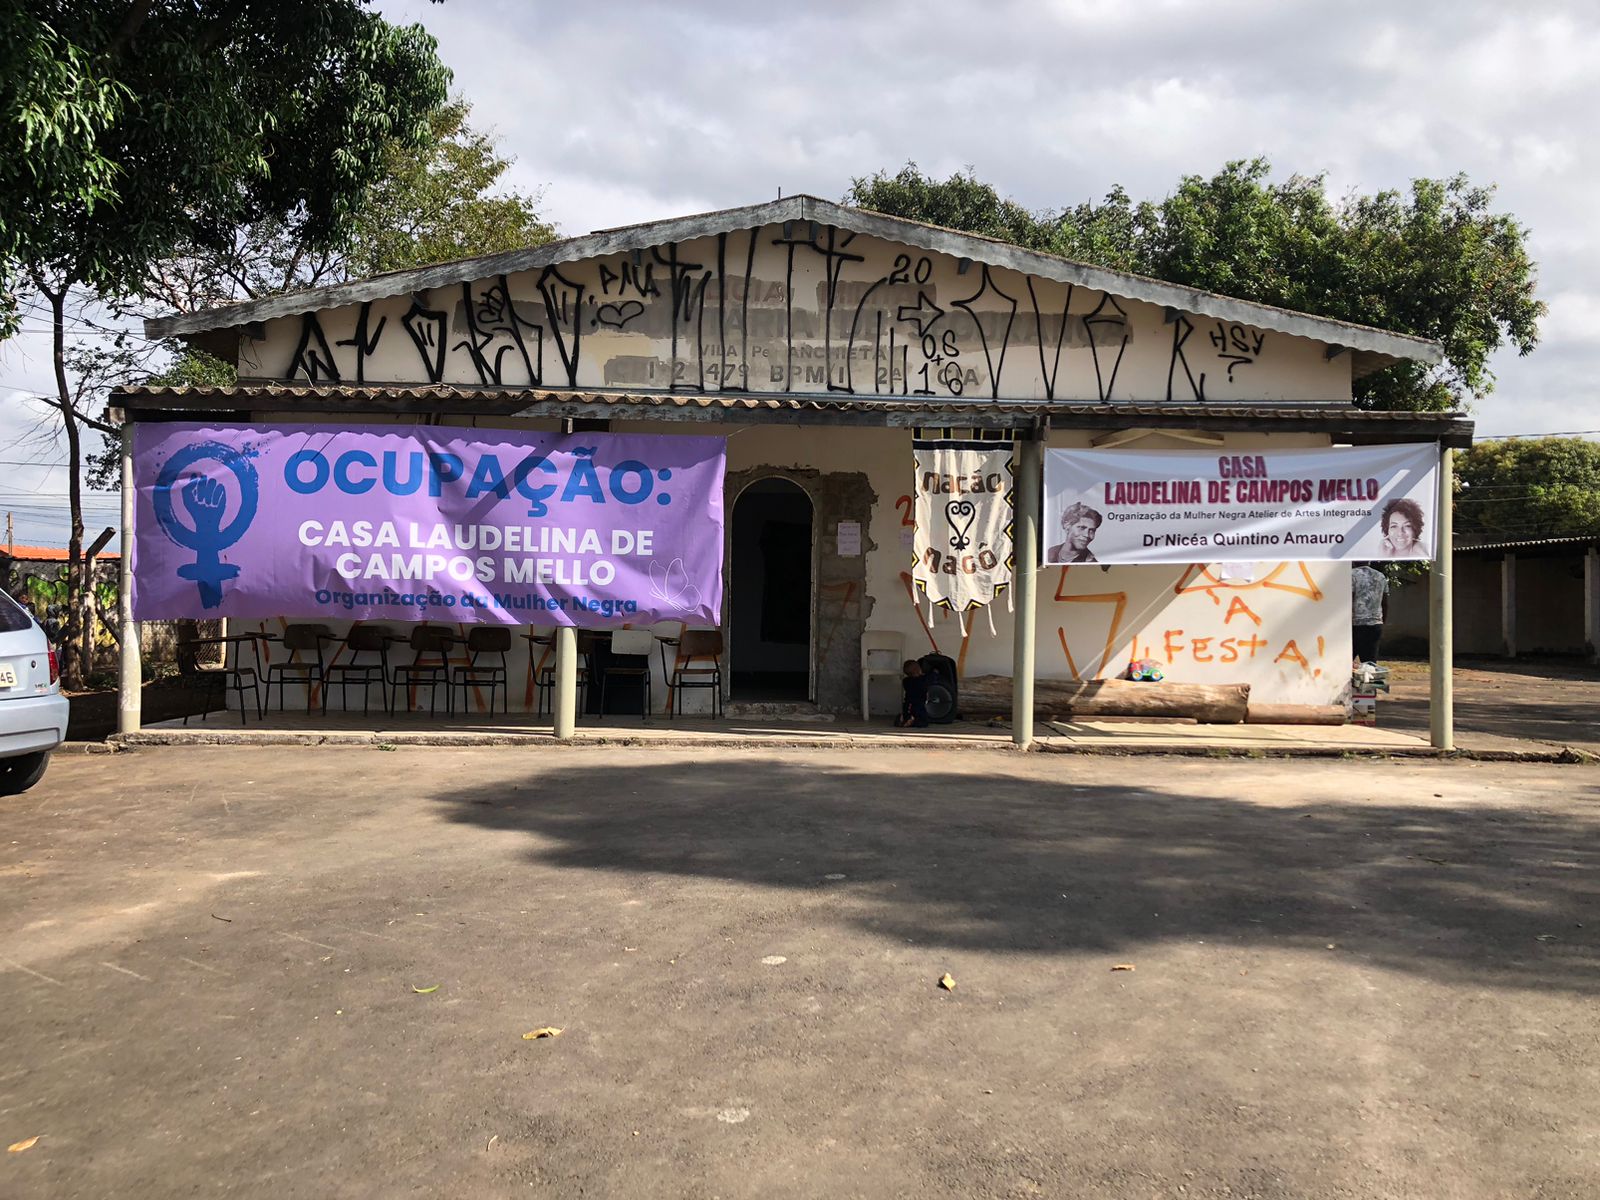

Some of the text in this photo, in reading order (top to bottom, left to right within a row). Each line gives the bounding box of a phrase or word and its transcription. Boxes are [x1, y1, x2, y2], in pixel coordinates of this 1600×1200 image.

[284, 446, 673, 518] OCUPAÇÃO:
[1218, 456, 1268, 479] CASA
[1104, 477, 1379, 505] LAUDELINA DE CAMPOS MELLO
[1107, 508, 1372, 522] Organização da Mulher Negra Atelier de Artes Integradas
[298, 519, 655, 556] CASA LAUDELINA DE
[1213, 532, 1280, 546] Quintino
[1283, 531, 1345, 545] Amauro
[336, 553, 616, 586] CAMPOS MELLO
[315, 588, 456, 611] Organização
[494, 592, 569, 611] Mulher
[572, 596, 638, 618] Negra
